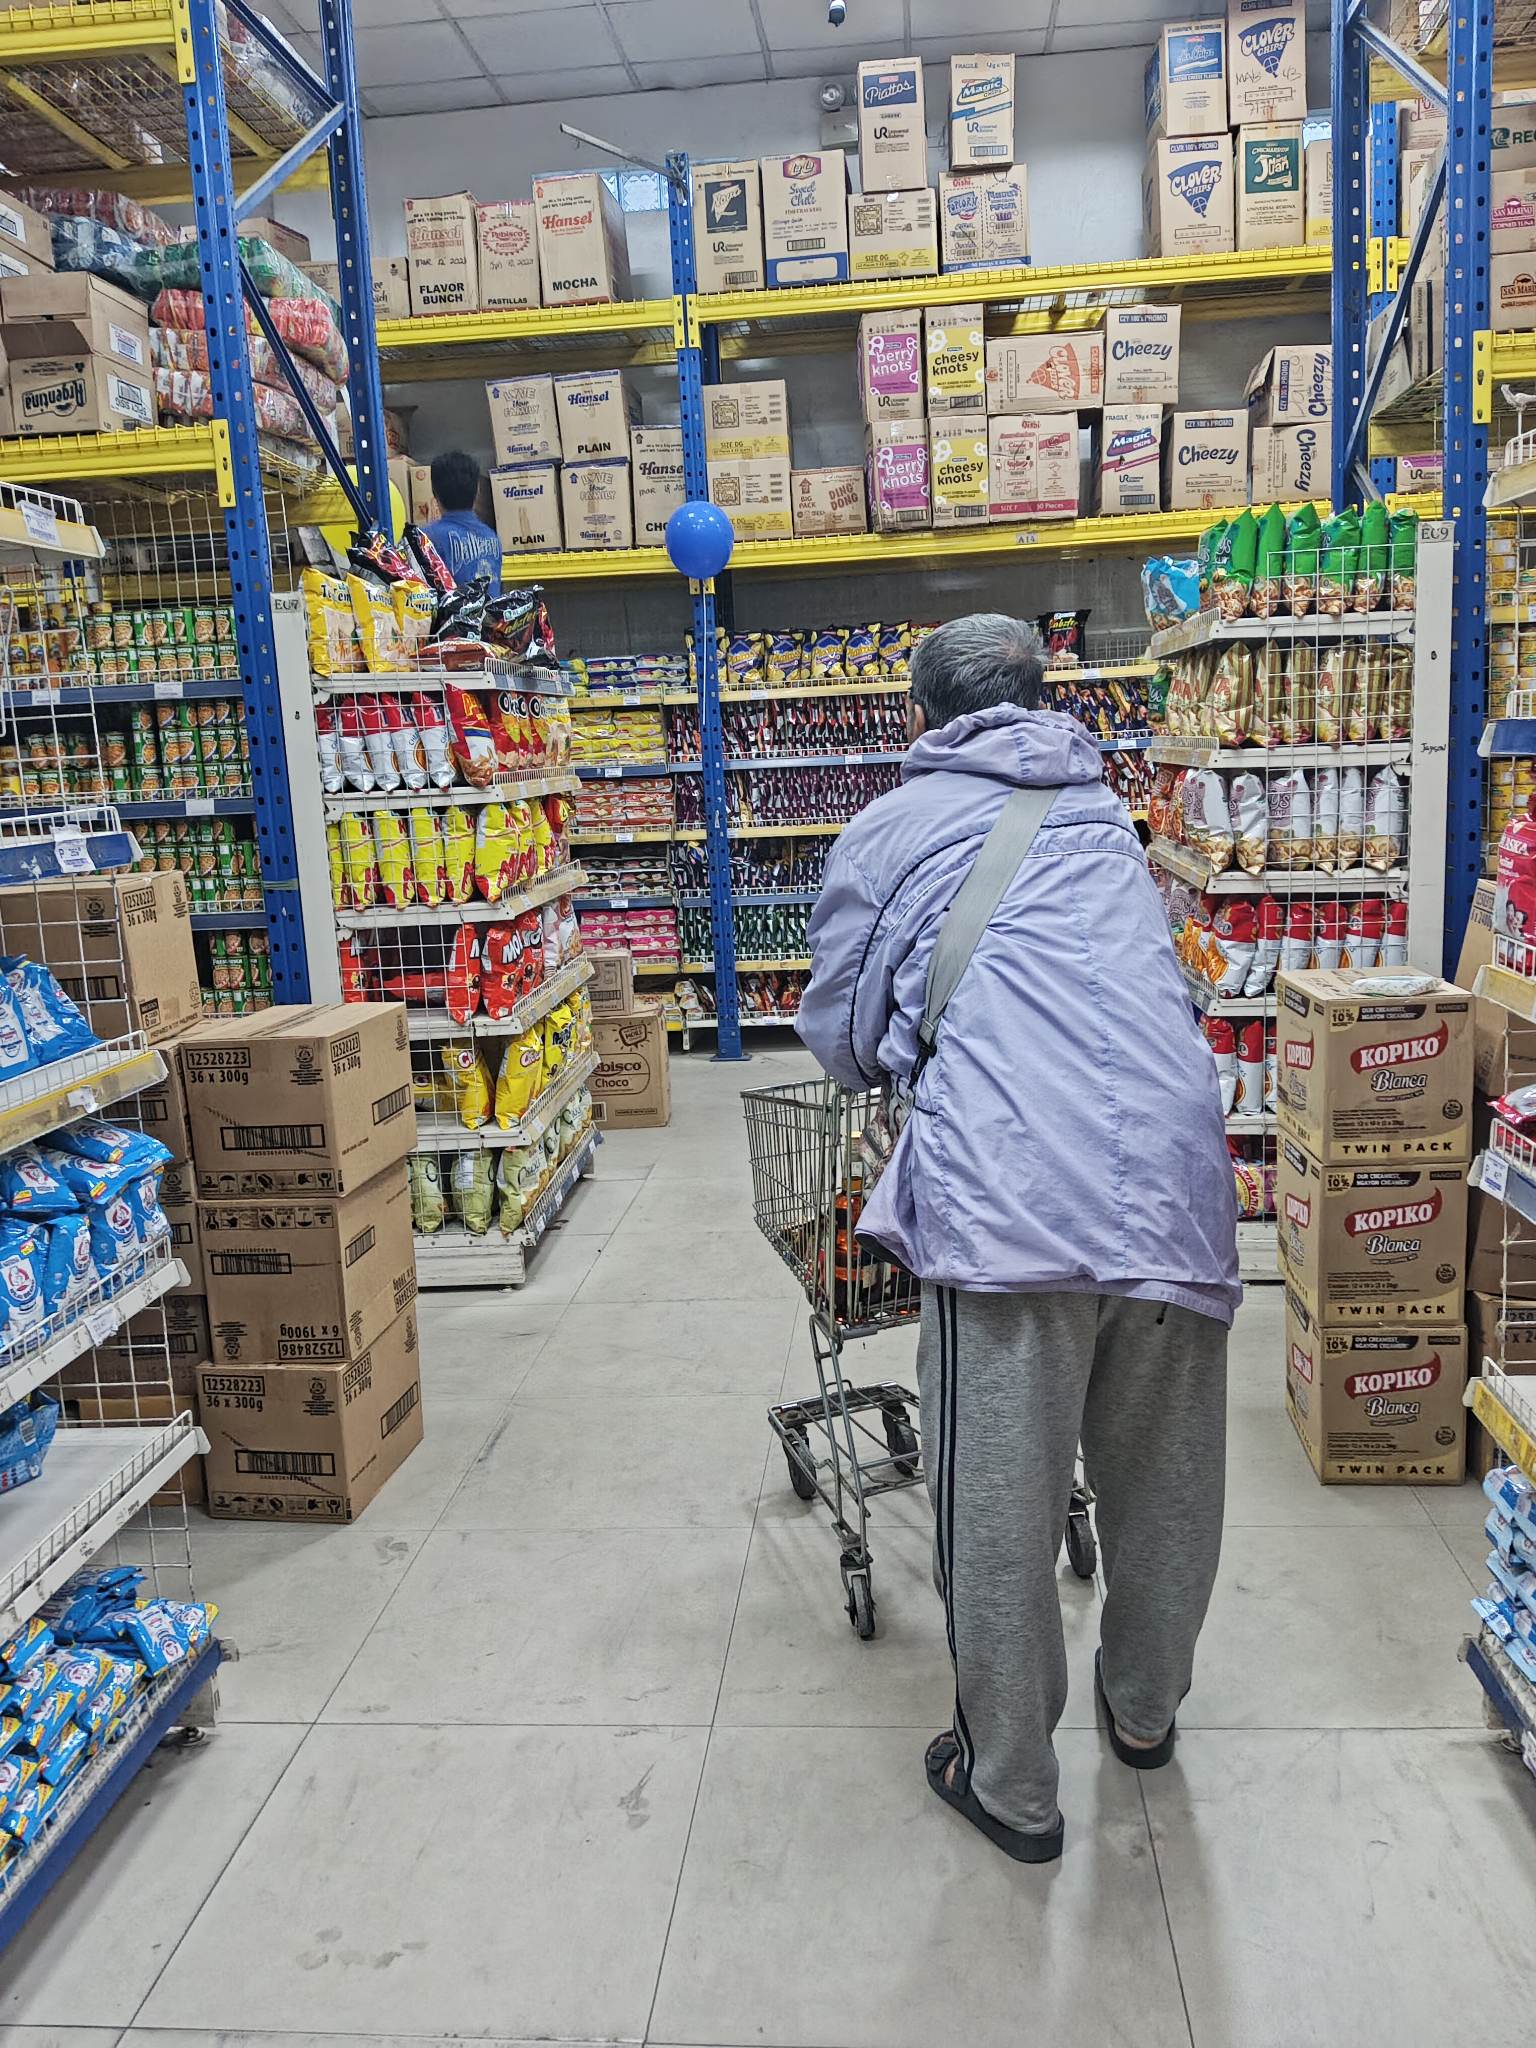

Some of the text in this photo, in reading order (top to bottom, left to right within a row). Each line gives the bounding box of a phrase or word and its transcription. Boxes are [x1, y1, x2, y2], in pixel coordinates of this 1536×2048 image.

[1241, 23, 1295, 56] CLOVER
[1257, 42, 1285, 56] CHIPS
[865, 82, 915, 102] Piattos
[961, 81, 1002, 98] Magic
[874, 127, 888, 139] UR
[967, 122, 979, 133] UR
[953, 177, 971, 187] Oishi
[1171, 165, 1221, 196] CLOVER
[1187, 183, 1212, 197] CHIPS
[1493, 206, 1533, 217] SAN MARINO
[542, 211, 593, 230] Hansel
[419, 282, 465, 295] FLAVOR
[552, 277, 598, 291] MOCHA
[1503, 286, 1517, 296] SAN
[422, 293, 463, 305] BUNCH
[487, 297, 528, 305] PASTILLAS
[1145, 314, 1167, 322] PROMO
[876, 348, 914, 363] berry
[1112, 340, 1173, 361] Cheezy
[934, 351, 979, 366] cheesy
[872, 361, 912, 377] knots
[932, 363, 969, 376] knots
[1280, 361, 1288, 385] PROMO
[1309, 353, 1331, 417] Cheezy
[25, 380, 84, 410] Argentina
[568, 391, 609, 405] Hansel
[1113, 432, 1151, 447] Magic
[577, 443, 611, 453] PLAIN
[1179, 446, 1239, 465] Cheezy
[1295, 429, 1316, 492] Cheezy
[640, 462, 683, 475] Hanse
[886, 460, 924, 475] berry
[940, 462, 983, 475] cheesy
[581, 472, 613, 486] LOVE
[882, 475, 923, 489] knots
[937, 473, 973, 486] knots
[503, 485, 544, 498] Hansel
[828, 483, 854, 500] DING
[831, 494, 858, 510] DONG
[512, 535, 545, 545] PLAIN
[1332, 1013, 1355, 1022] 10%
[333, 1036, 360, 1058] 12528223
[1360, 1037, 1439, 1068] KOPIKO
[190, 1052, 247, 1066] 12528223
[1287, 1044, 1311, 1067] KOPIKO
[333, 1063, 341, 1076] 36
[191, 1070, 249, 1085] 36 x 300g
[595, 1078, 629, 1088] Choco
[1372, 1069, 1428, 1092] Blanca
[1342, 1142, 1452, 1154] TWIN PACK
[1327, 1179, 1349, 1187] 10%
[1354, 1203, 1432, 1232] KOPIKO
[1367, 1234, 1421, 1254] Blanca
[1338, 1305, 1446, 1314] TWIN PACK
[280, 1324, 315, 1338] 1900g
[332, 1325, 339, 1337] 6
[281, 1342, 341, 1355] 12528486
[344, 1357, 370, 1388] 12528223
[206, 1378, 262, 1393] 12528223
[1354, 1368, 1432, 1394] KOPIKO
[206, 1396, 263, 1412] 36 x 300g
[1366, 1396, 1420, 1417] Blanca
[1337, 1465, 1445, 1474] TWIN PACK
